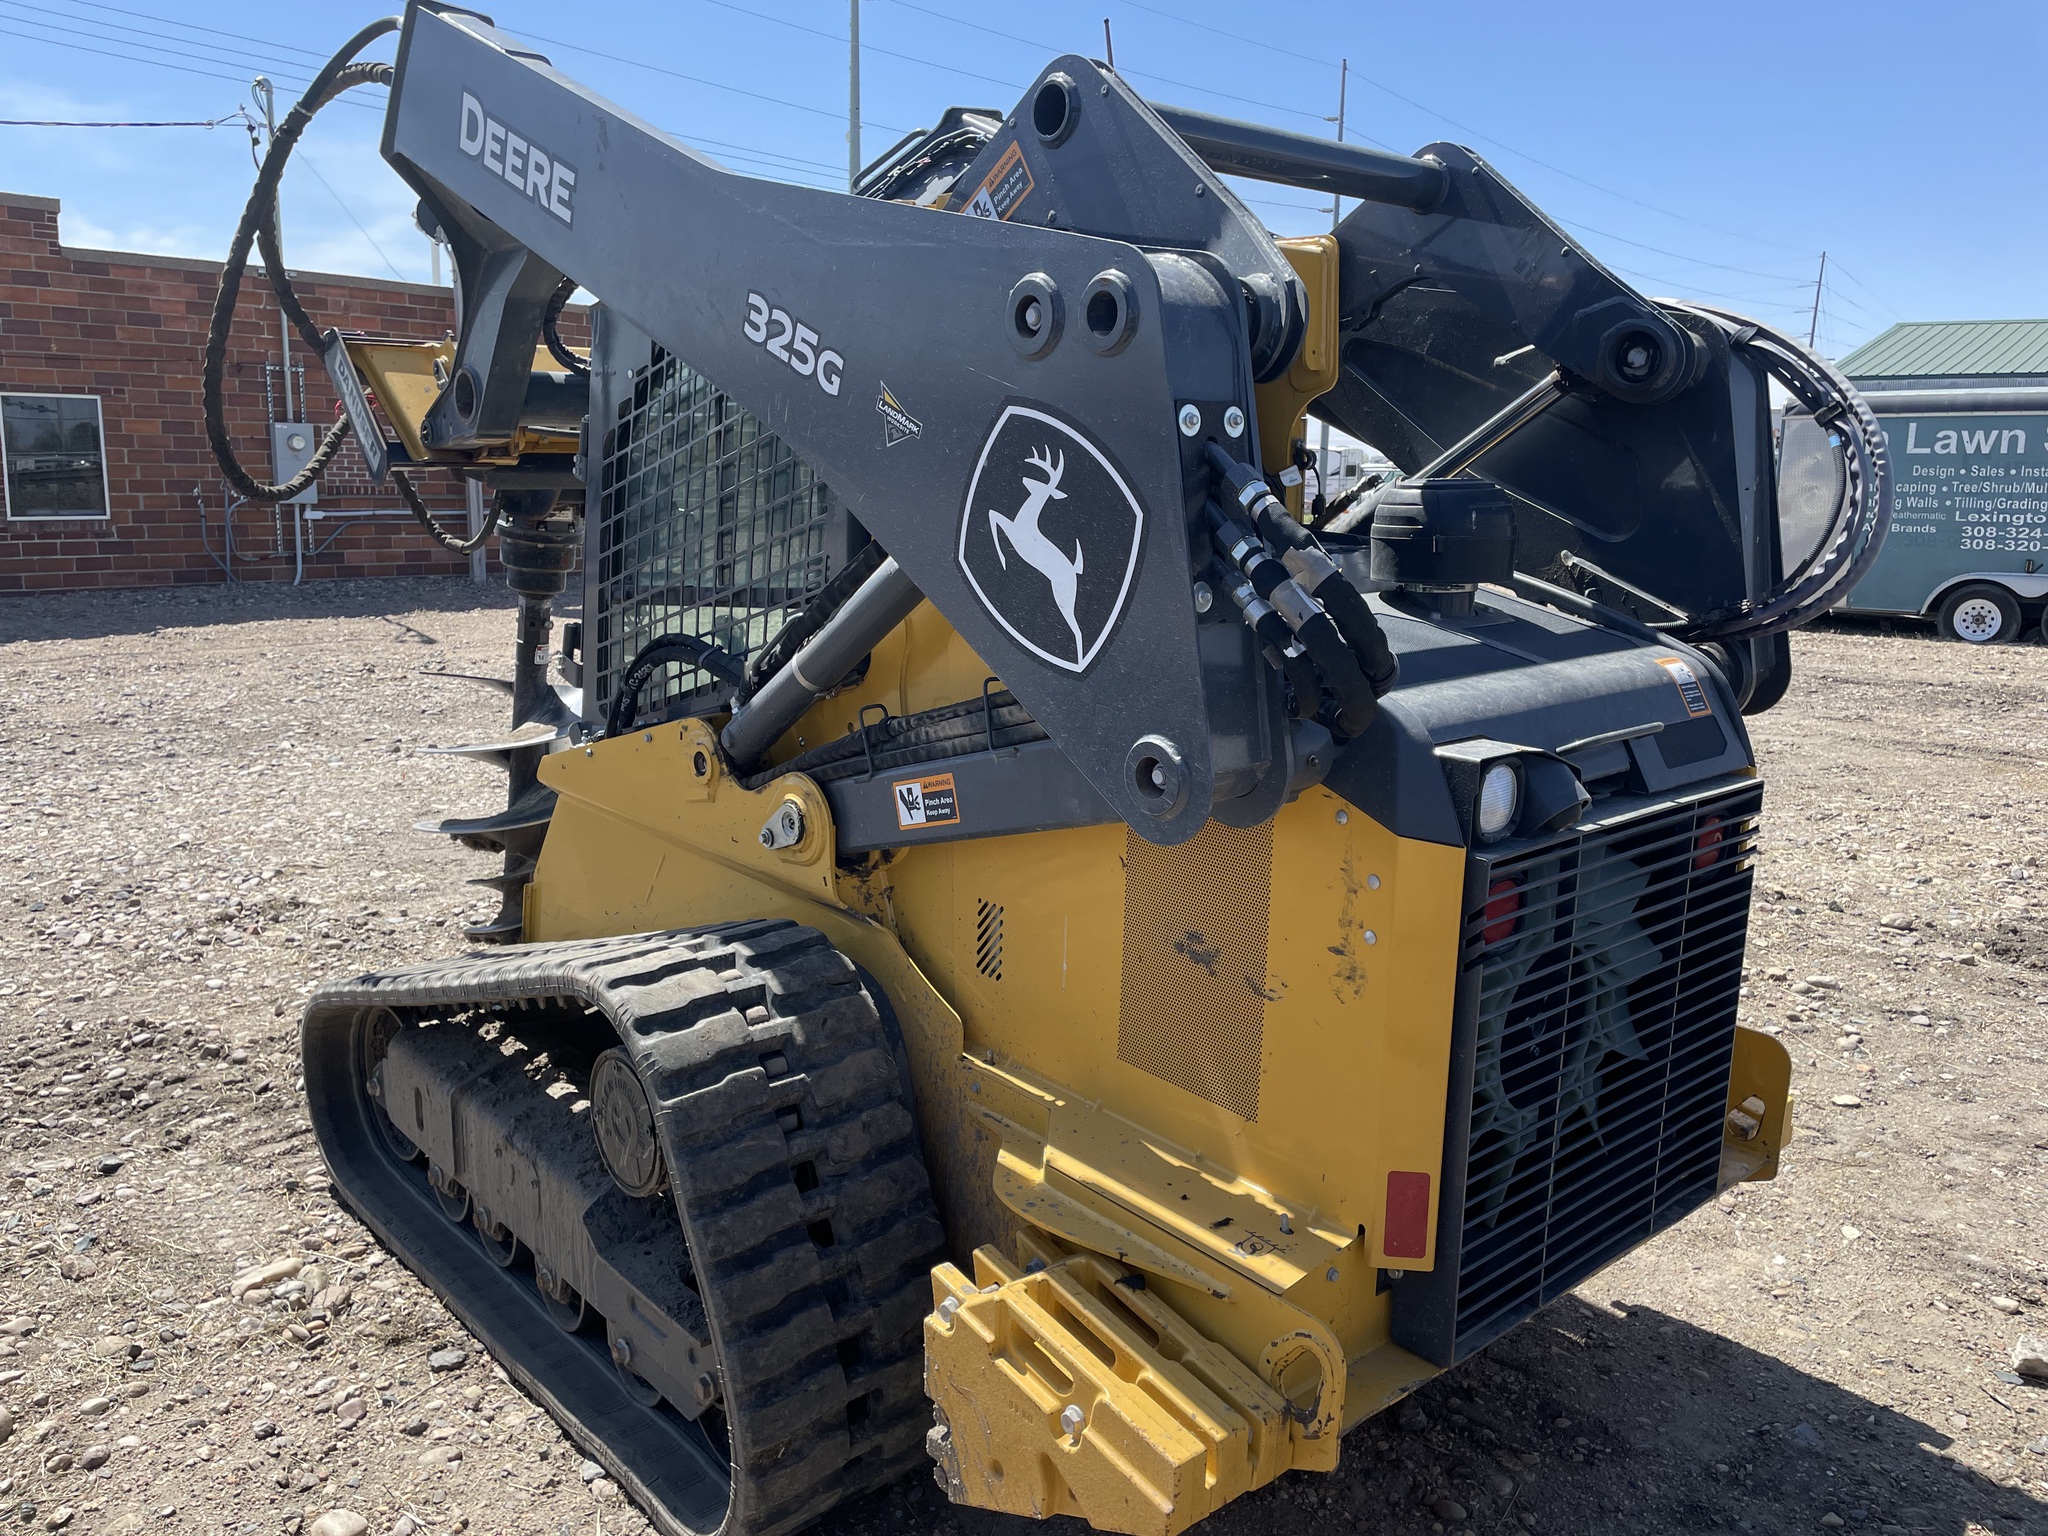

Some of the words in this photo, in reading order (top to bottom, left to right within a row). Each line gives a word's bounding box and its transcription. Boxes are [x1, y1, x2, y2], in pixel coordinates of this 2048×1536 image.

[459, 91, 576, 224] DEERE
[993, 149, 1017, 182] WARNING
[993, 182, 1010, 204] Pinch
[1009, 166, 1023, 186] Area
[997, 197, 1010, 214] Keep
[1009, 181, 1023, 199] Away
[743, 292, 844, 396] 325G
[338, 358, 378, 458] DANUSER
[878, 400, 920, 435] LANDMARK
[886, 415, 910, 435] WORKSITE
[1906, 422, 2027, 454] Lawn
[1912, 465, 1955, 479] Design
[1970, 465, 2005, 477] Sales
[1905, 496, 1939, 508] Walls
[1954, 497, 2048, 512] Tilling/Grading
[1892, 511, 1946, 520] eathermatic
[1955, 511, 2047, 526] Lexingto
[1891, 523, 1937, 534] Brands
[1961, 526, 2048, 539] 308-324-
[1960, 538, 2048, 552] 308-320-
[927, 778, 951, 790] WARNING
[924, 797, 940, 807] Pinch
[940, 796, 953, 804] Area
[926, 809, 938, 817] Keep
[938, 807, 951, 816] Away
